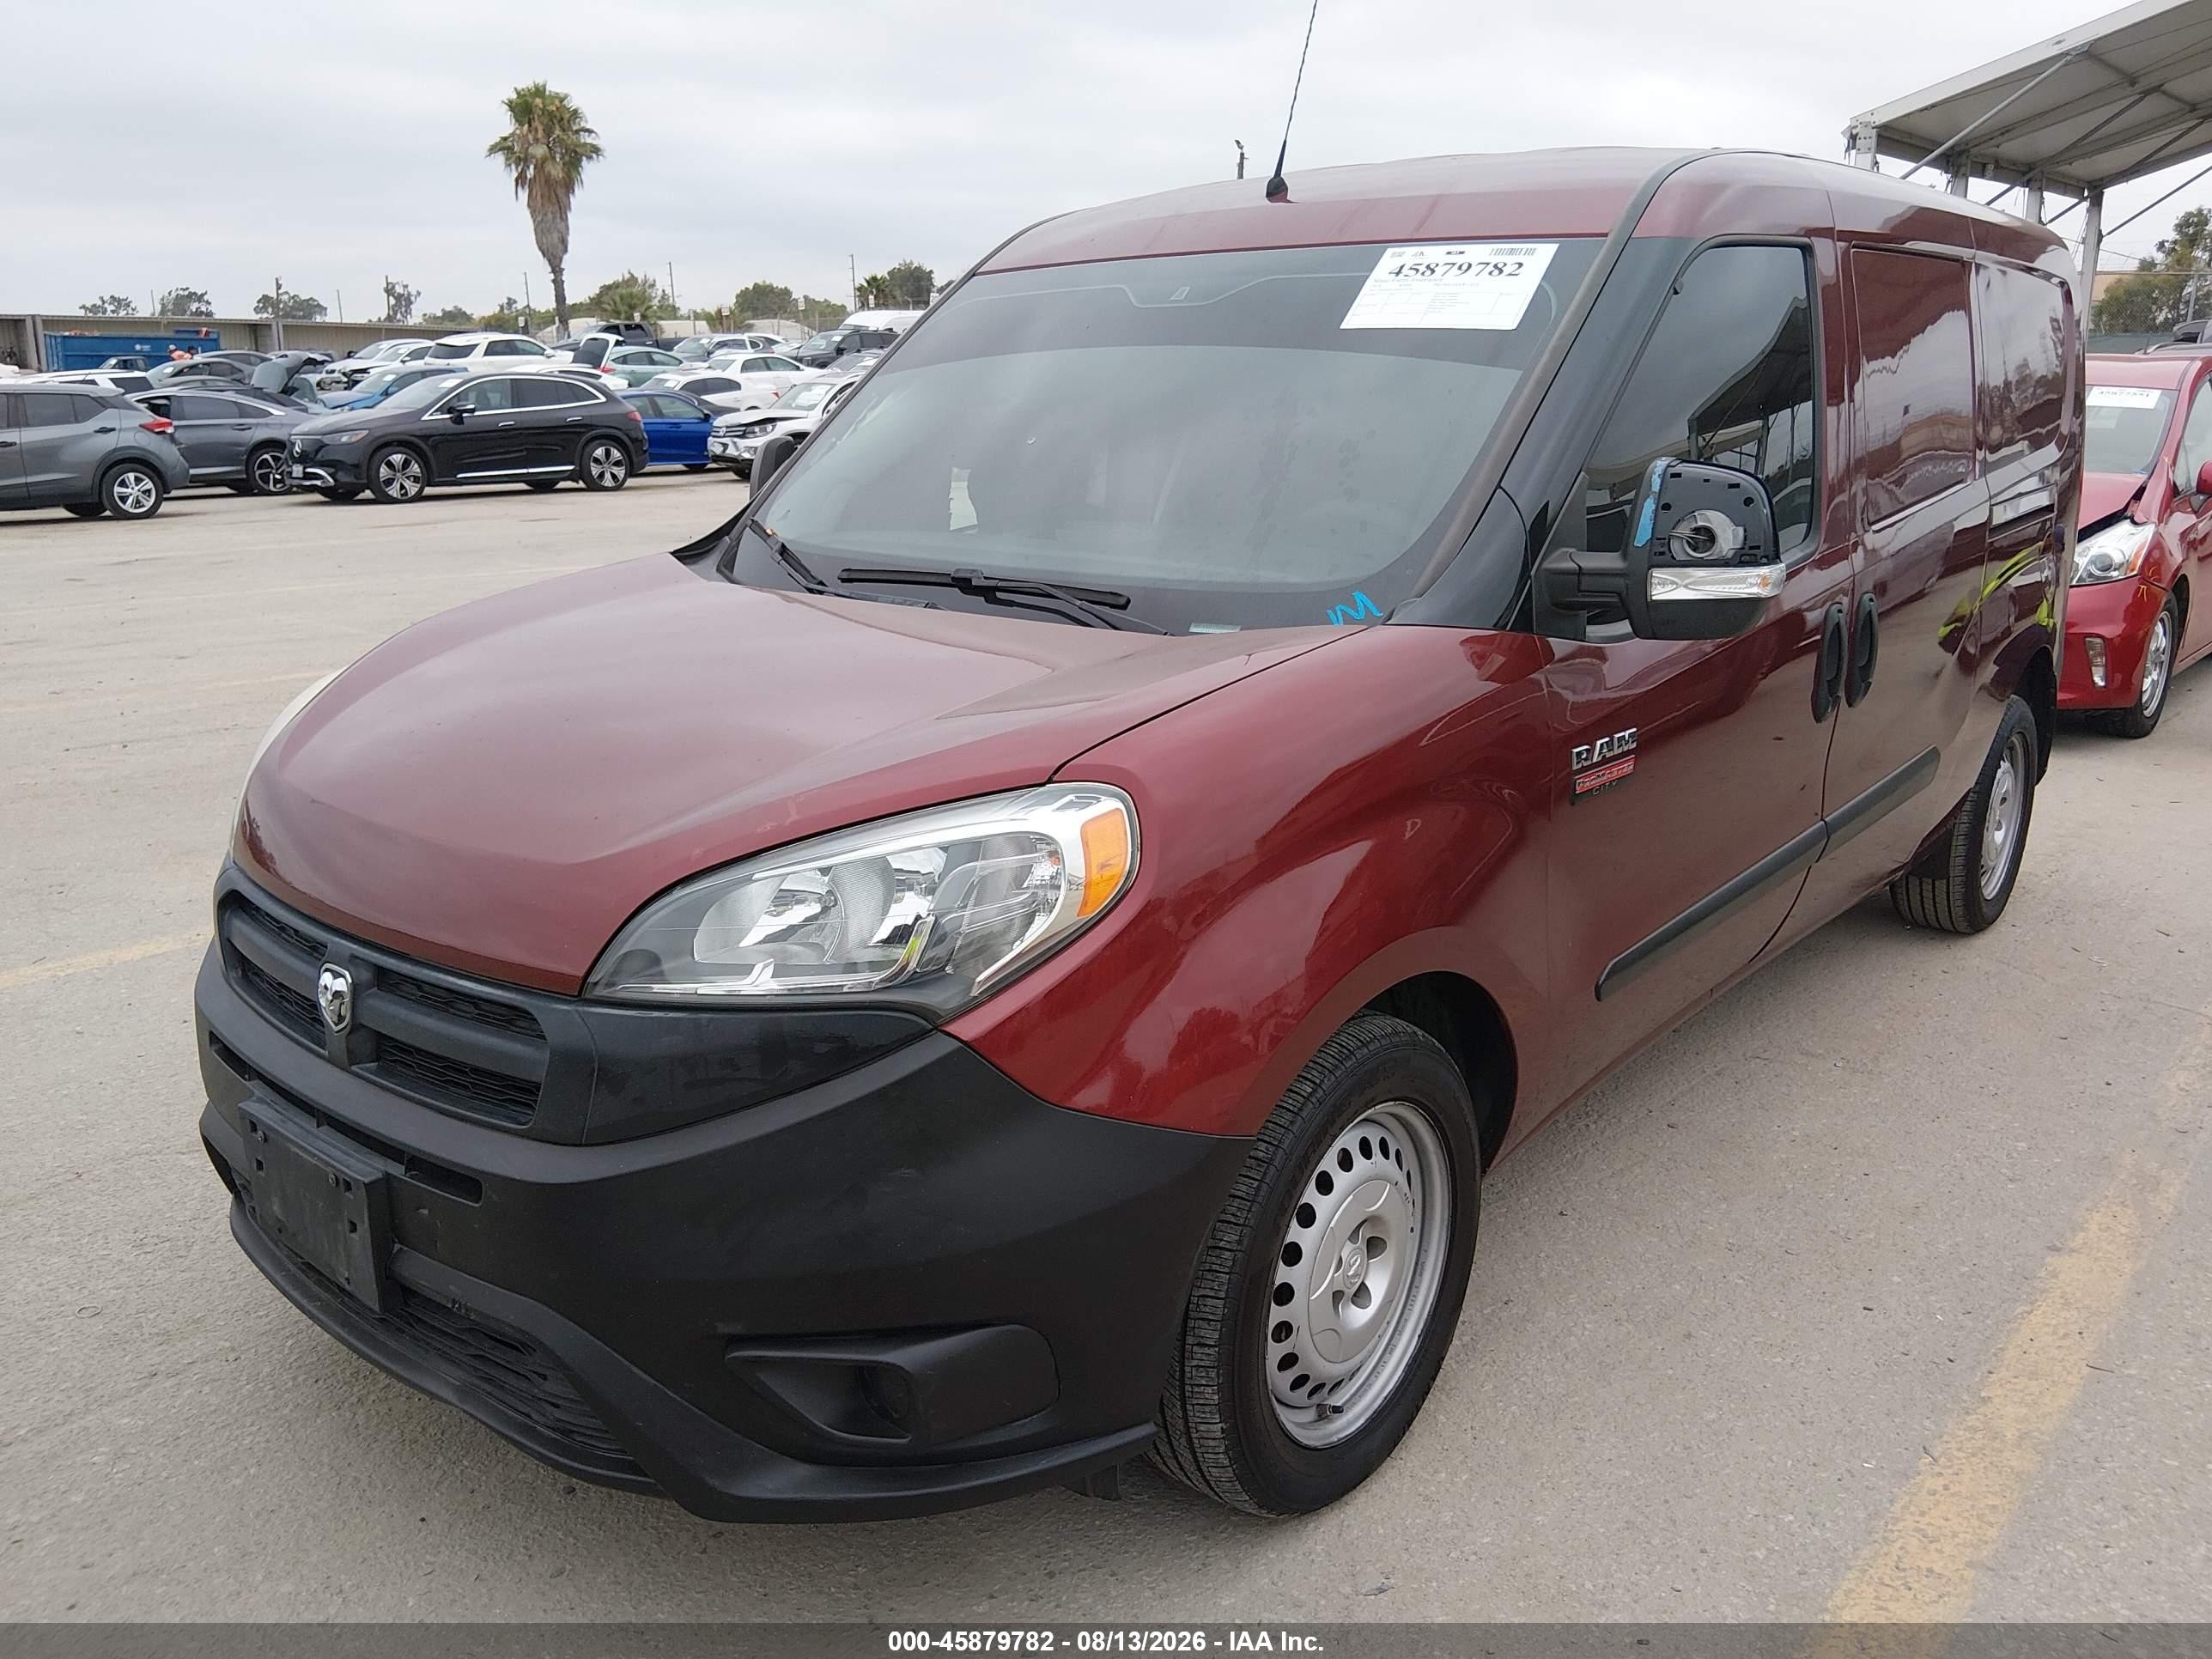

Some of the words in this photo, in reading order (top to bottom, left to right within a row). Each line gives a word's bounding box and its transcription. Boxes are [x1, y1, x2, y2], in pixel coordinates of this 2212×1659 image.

[1388, 261, 1524, 277] 45879782
[1571, 727, 1638, 770] RAM
[1592, 780, 1618, 796] CITY
